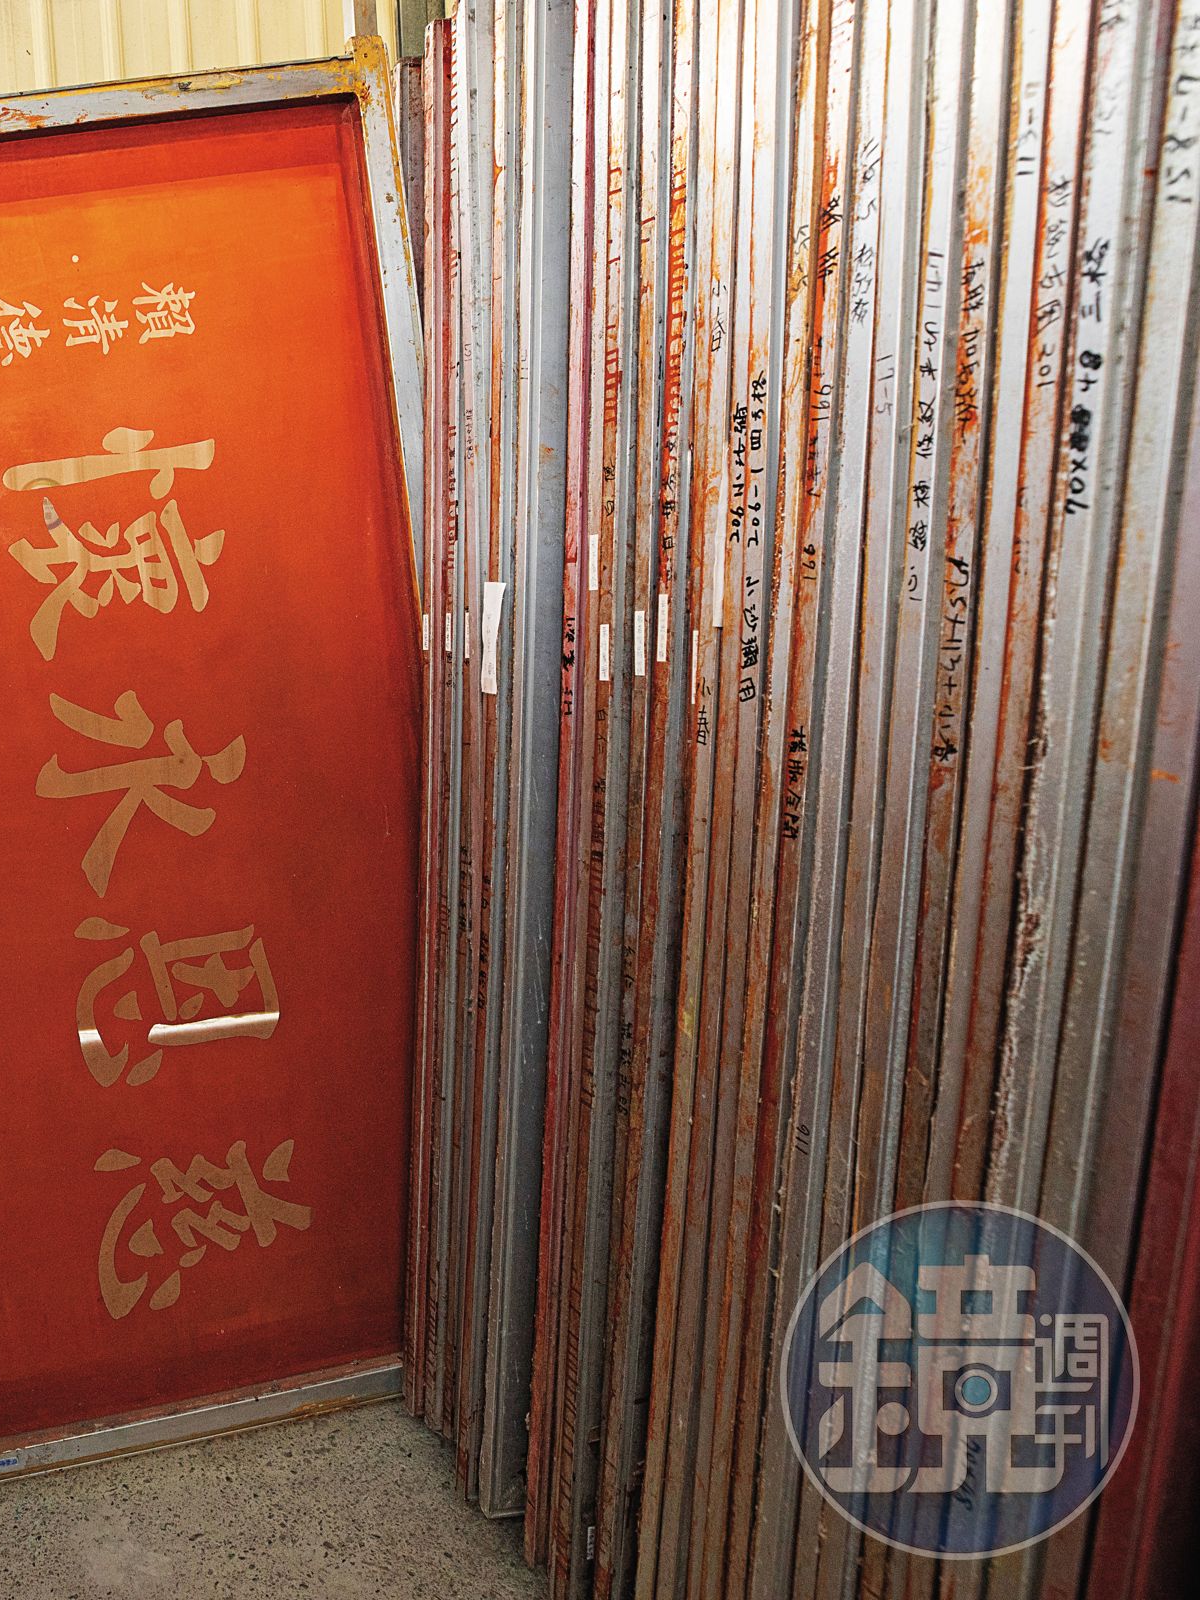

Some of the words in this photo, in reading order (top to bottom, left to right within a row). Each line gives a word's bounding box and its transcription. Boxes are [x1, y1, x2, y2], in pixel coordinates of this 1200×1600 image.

[876, 353, 895, 417] 17-5
[748, 467, 764, 548] 206-1
[795, 1124, 810, 1156] 116
